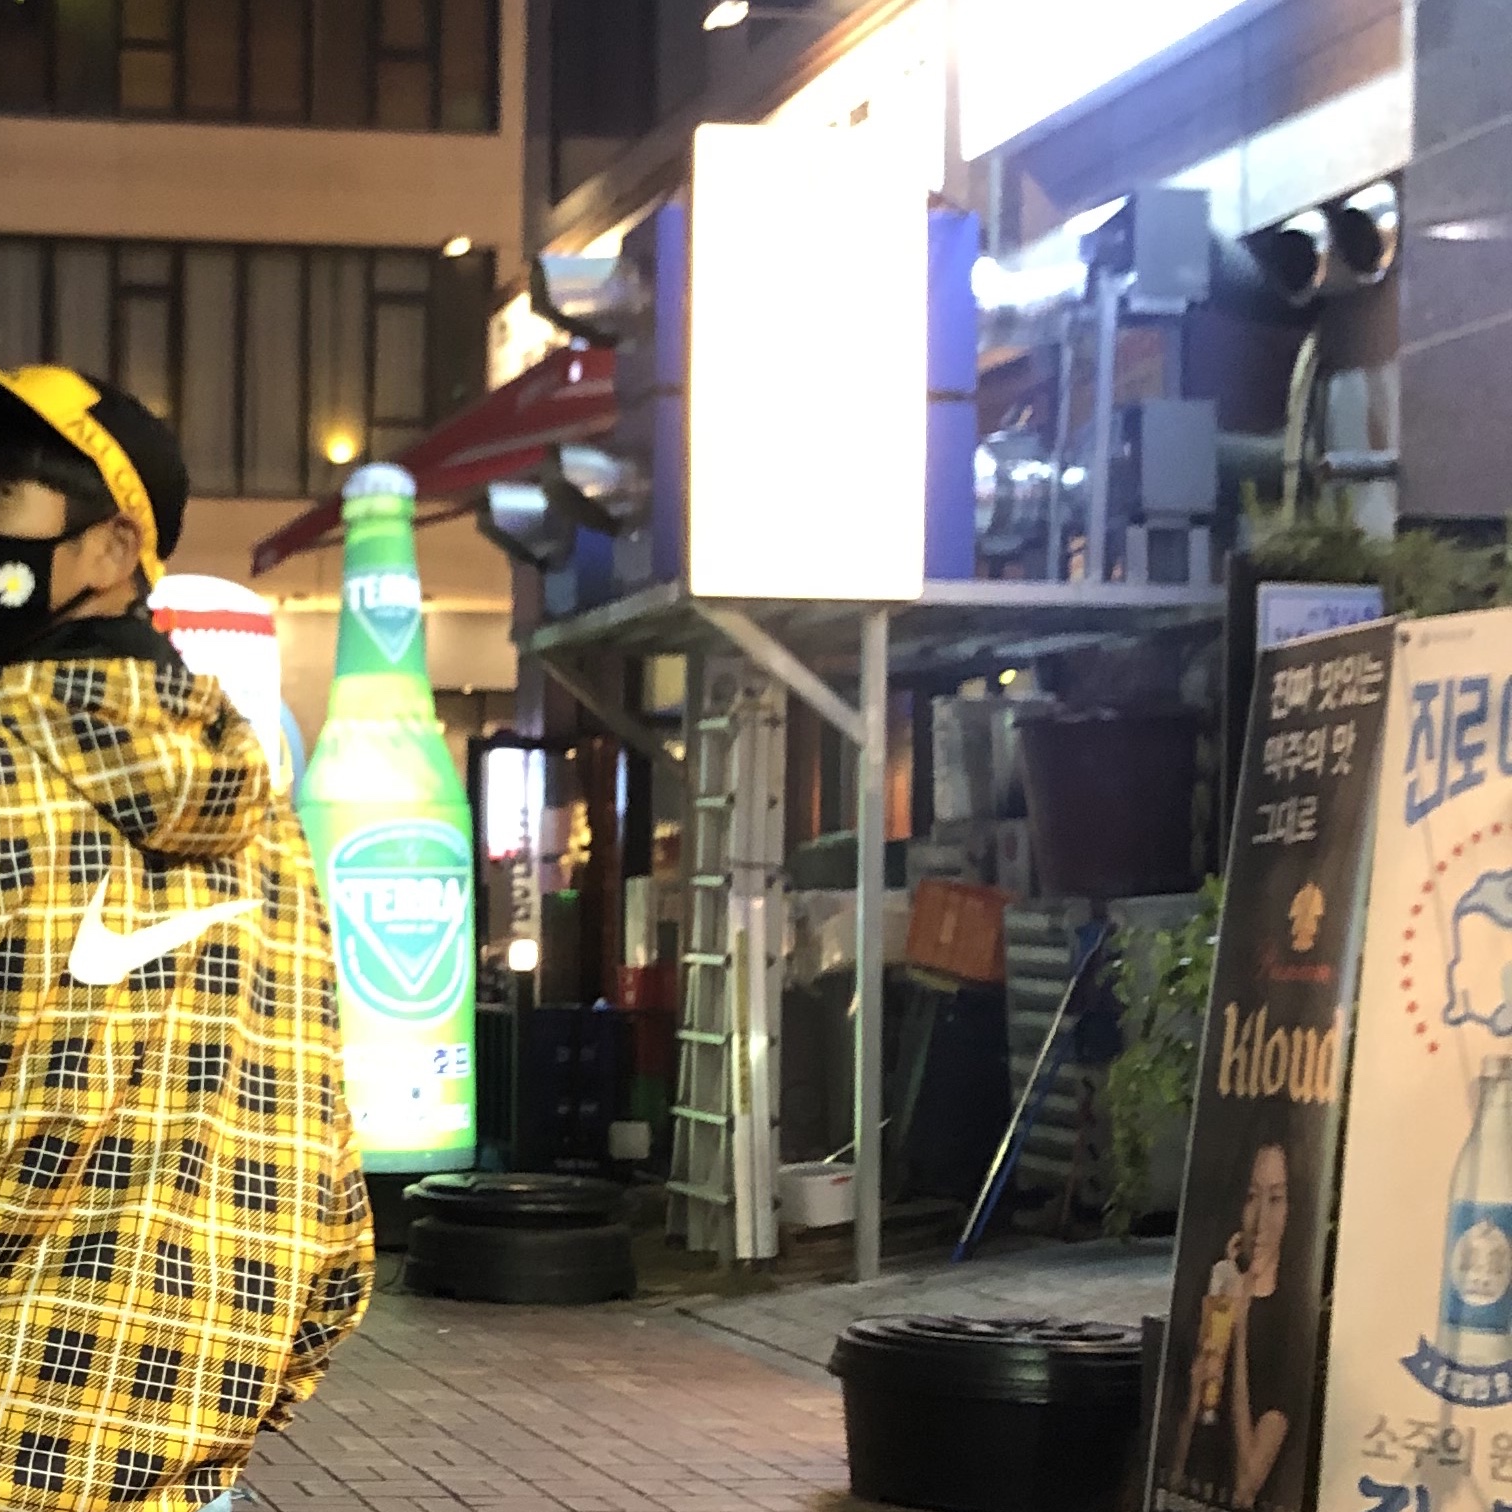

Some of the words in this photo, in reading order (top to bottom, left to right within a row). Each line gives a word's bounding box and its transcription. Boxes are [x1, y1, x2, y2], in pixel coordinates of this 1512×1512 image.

[1317, 653, 1384, 712] 맛있는
[1330, 719, 1357, 776] 맛
[1251, 794, 1320, 845] 그대로
[1361, 1413, 1476, 1476] 소주의
